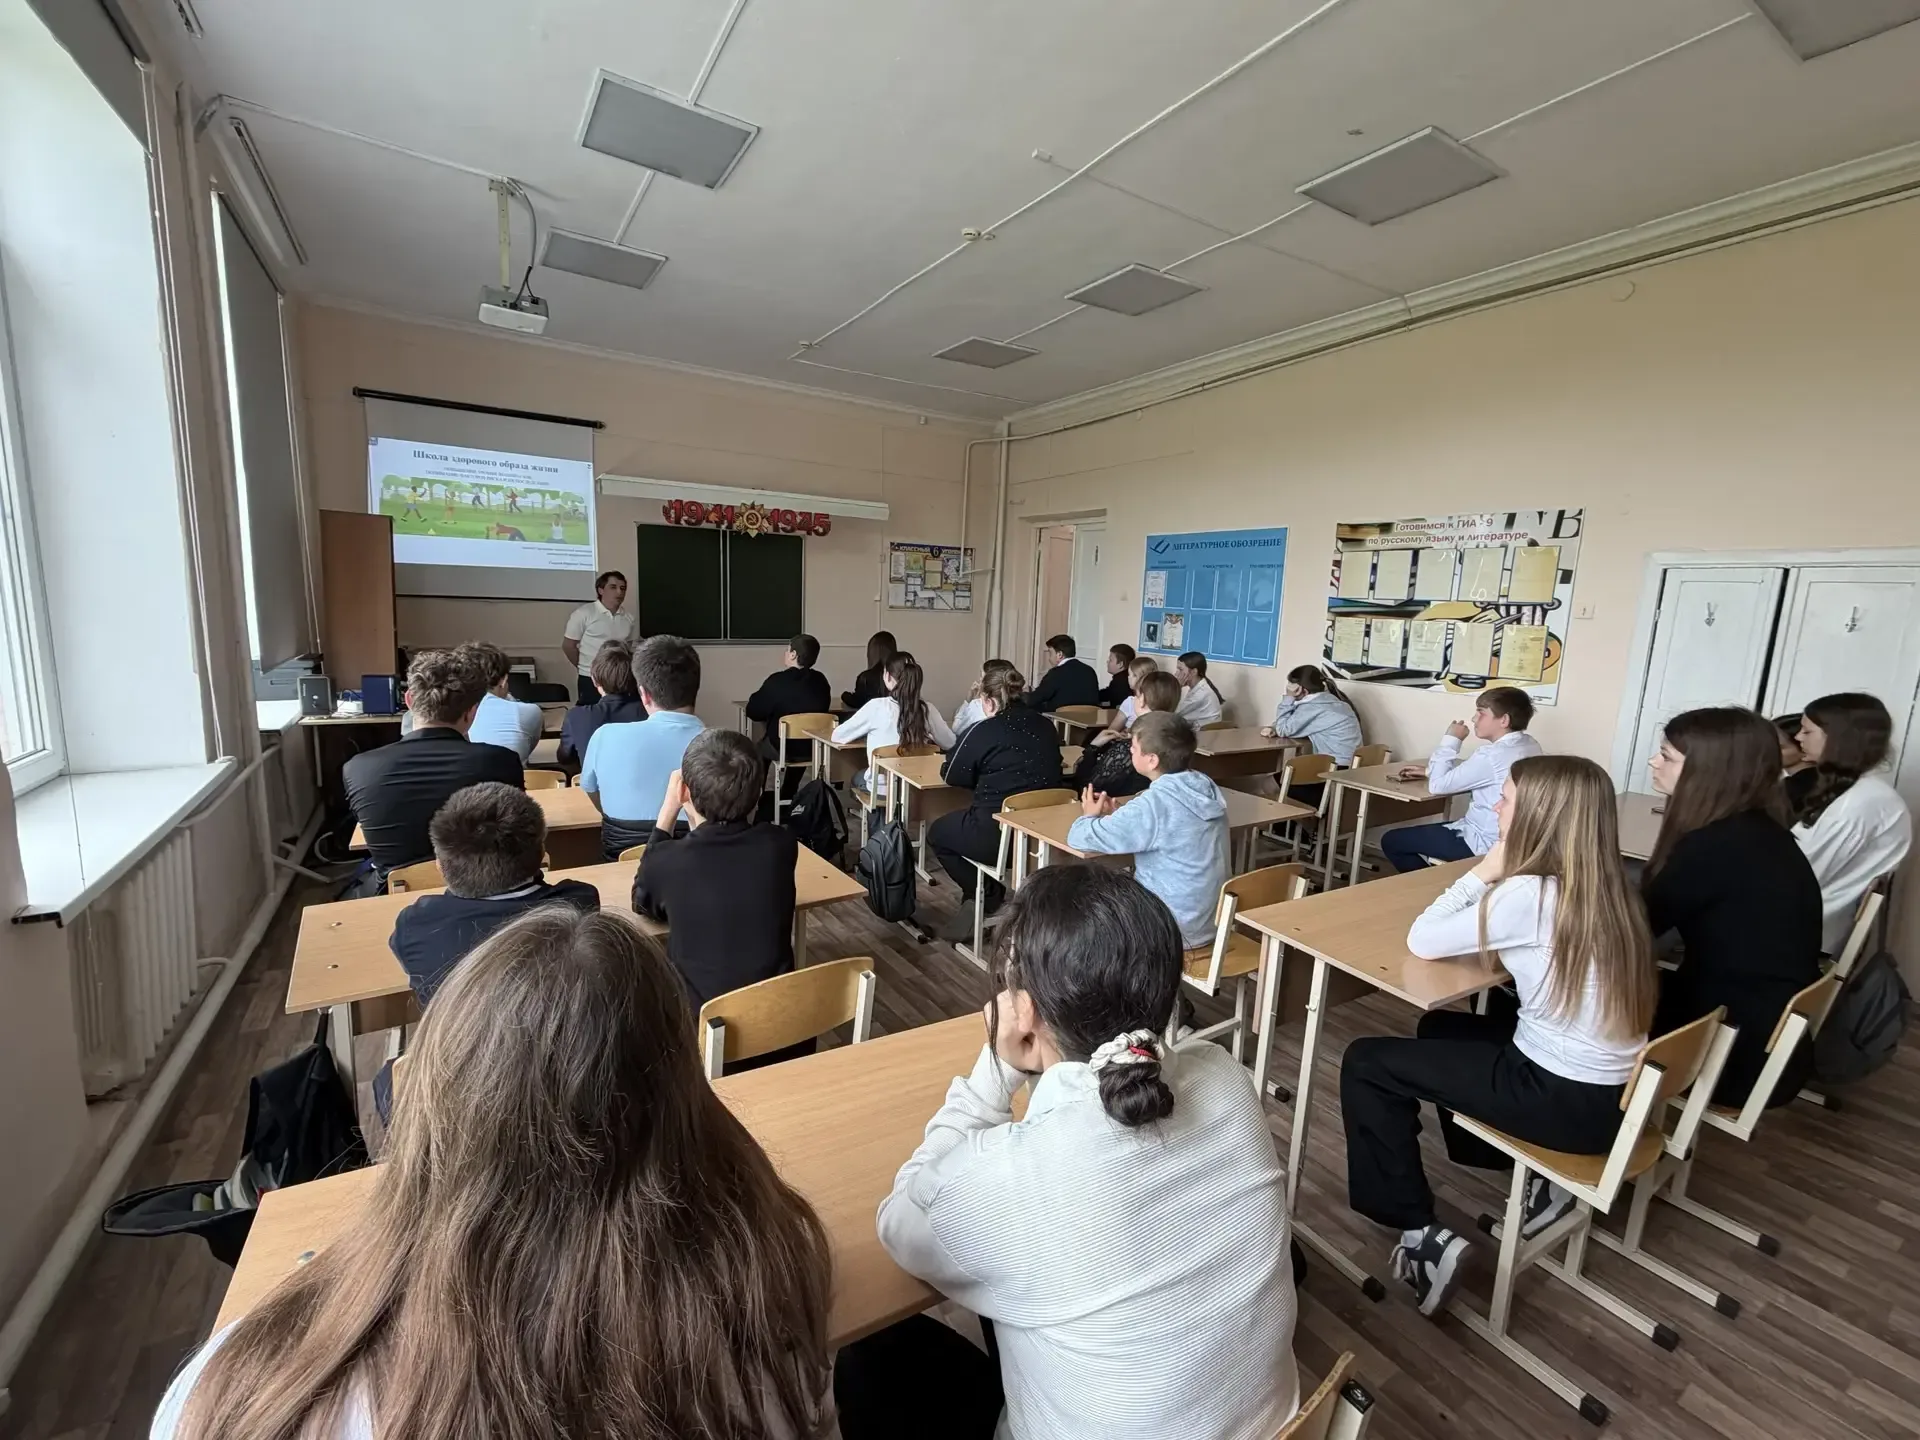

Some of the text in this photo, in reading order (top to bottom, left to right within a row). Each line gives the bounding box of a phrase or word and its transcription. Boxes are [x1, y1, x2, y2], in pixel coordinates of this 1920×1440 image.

[413, 450, 449, 461] Школа
[452, 456, 497, 466] здорового
[499, 460, 529, 470] образа
[531, 464, 559, 473] жизни
[672, 499, 735, 529] 1941
[770, 508, 832, 537] 1945
[1395, 522, 1446, 532] Готовимся
[1457, 519, 1477, 529] ГИА
[1486, 518, 1494, 527] 9
[1172, 538, 1282, 551] ЛИТЕРАТУРНОЕ ОБОЗРЕНИЕ
[1368, 537, 1379, 545] по
[1381, 535, 1423, 546] русскому
[1425, 534, 1455, 544] языку
[1467, 531, 1529, 542] литературе
[933, 546, 940, 557] 6
